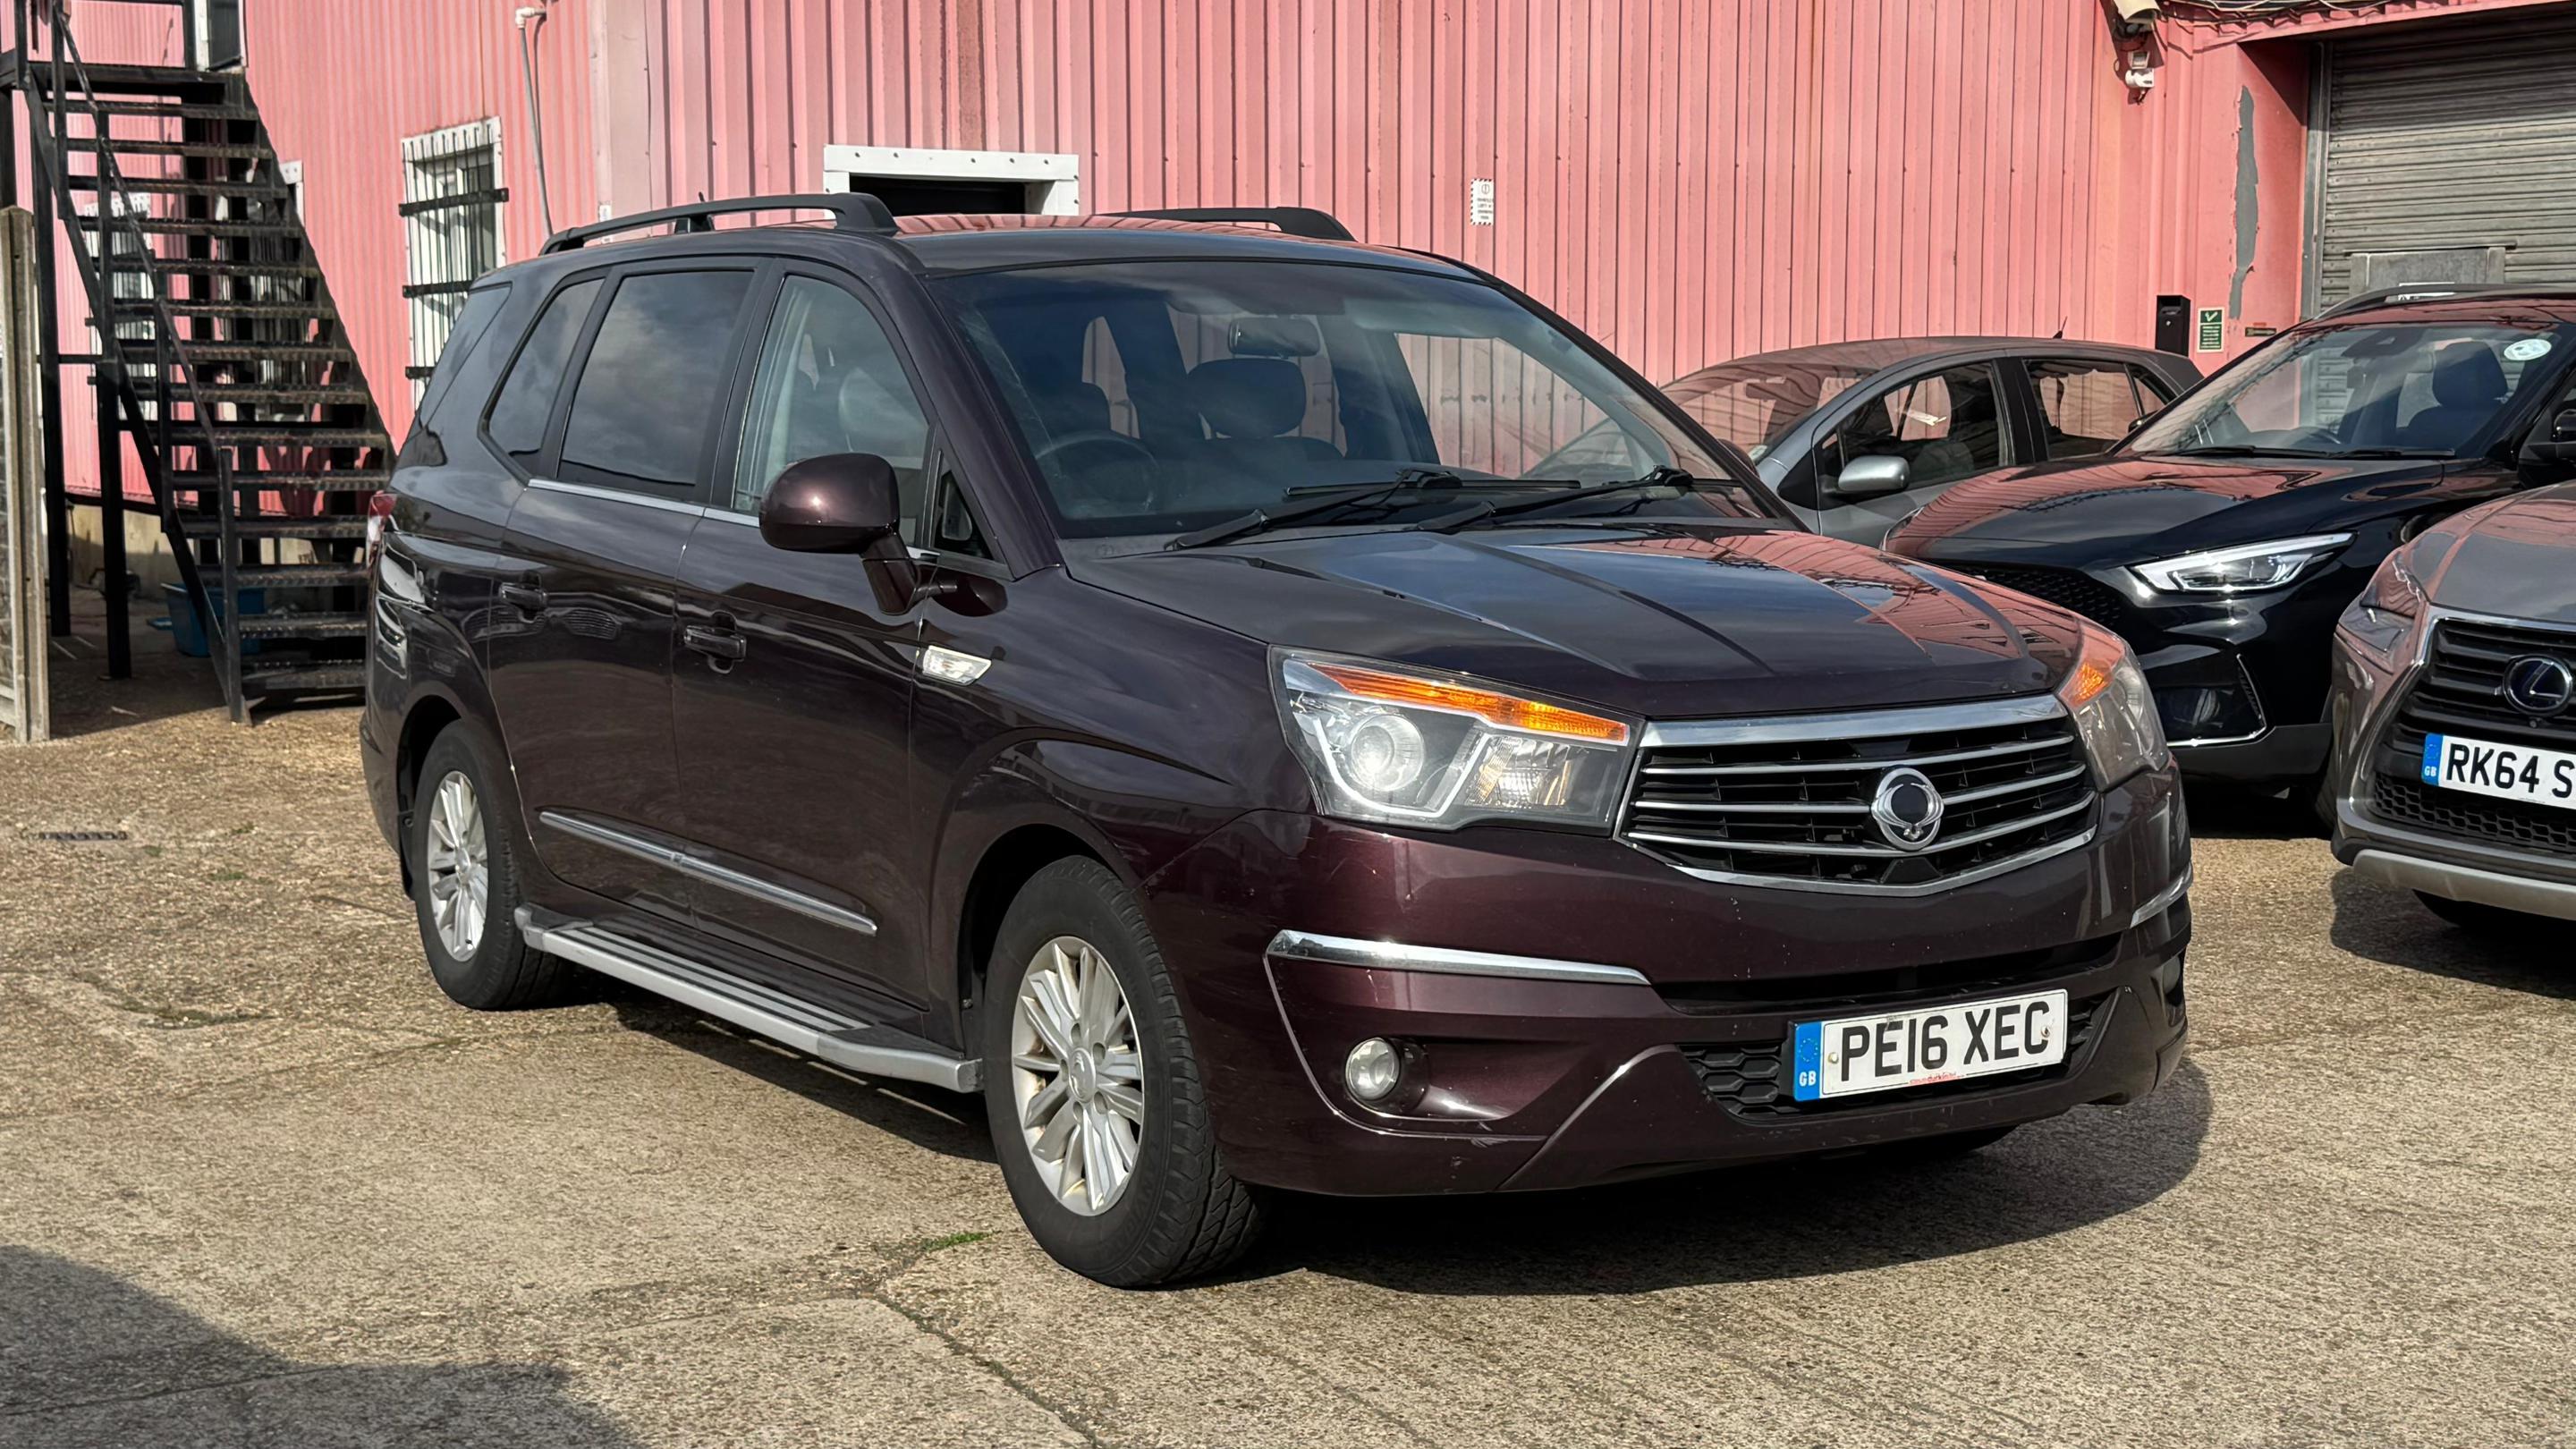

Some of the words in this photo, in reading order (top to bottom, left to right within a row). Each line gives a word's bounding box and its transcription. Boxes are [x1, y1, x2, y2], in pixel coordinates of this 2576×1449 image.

[2424, 766, 2437, 776] GB
[2446, 743, 2539, 793] RK64
[1841, 1015, 1948, 1081] PE16
[1963, 1001, 2050, 1065] XEC
[1799, 1071, 1817, 1087] GB
